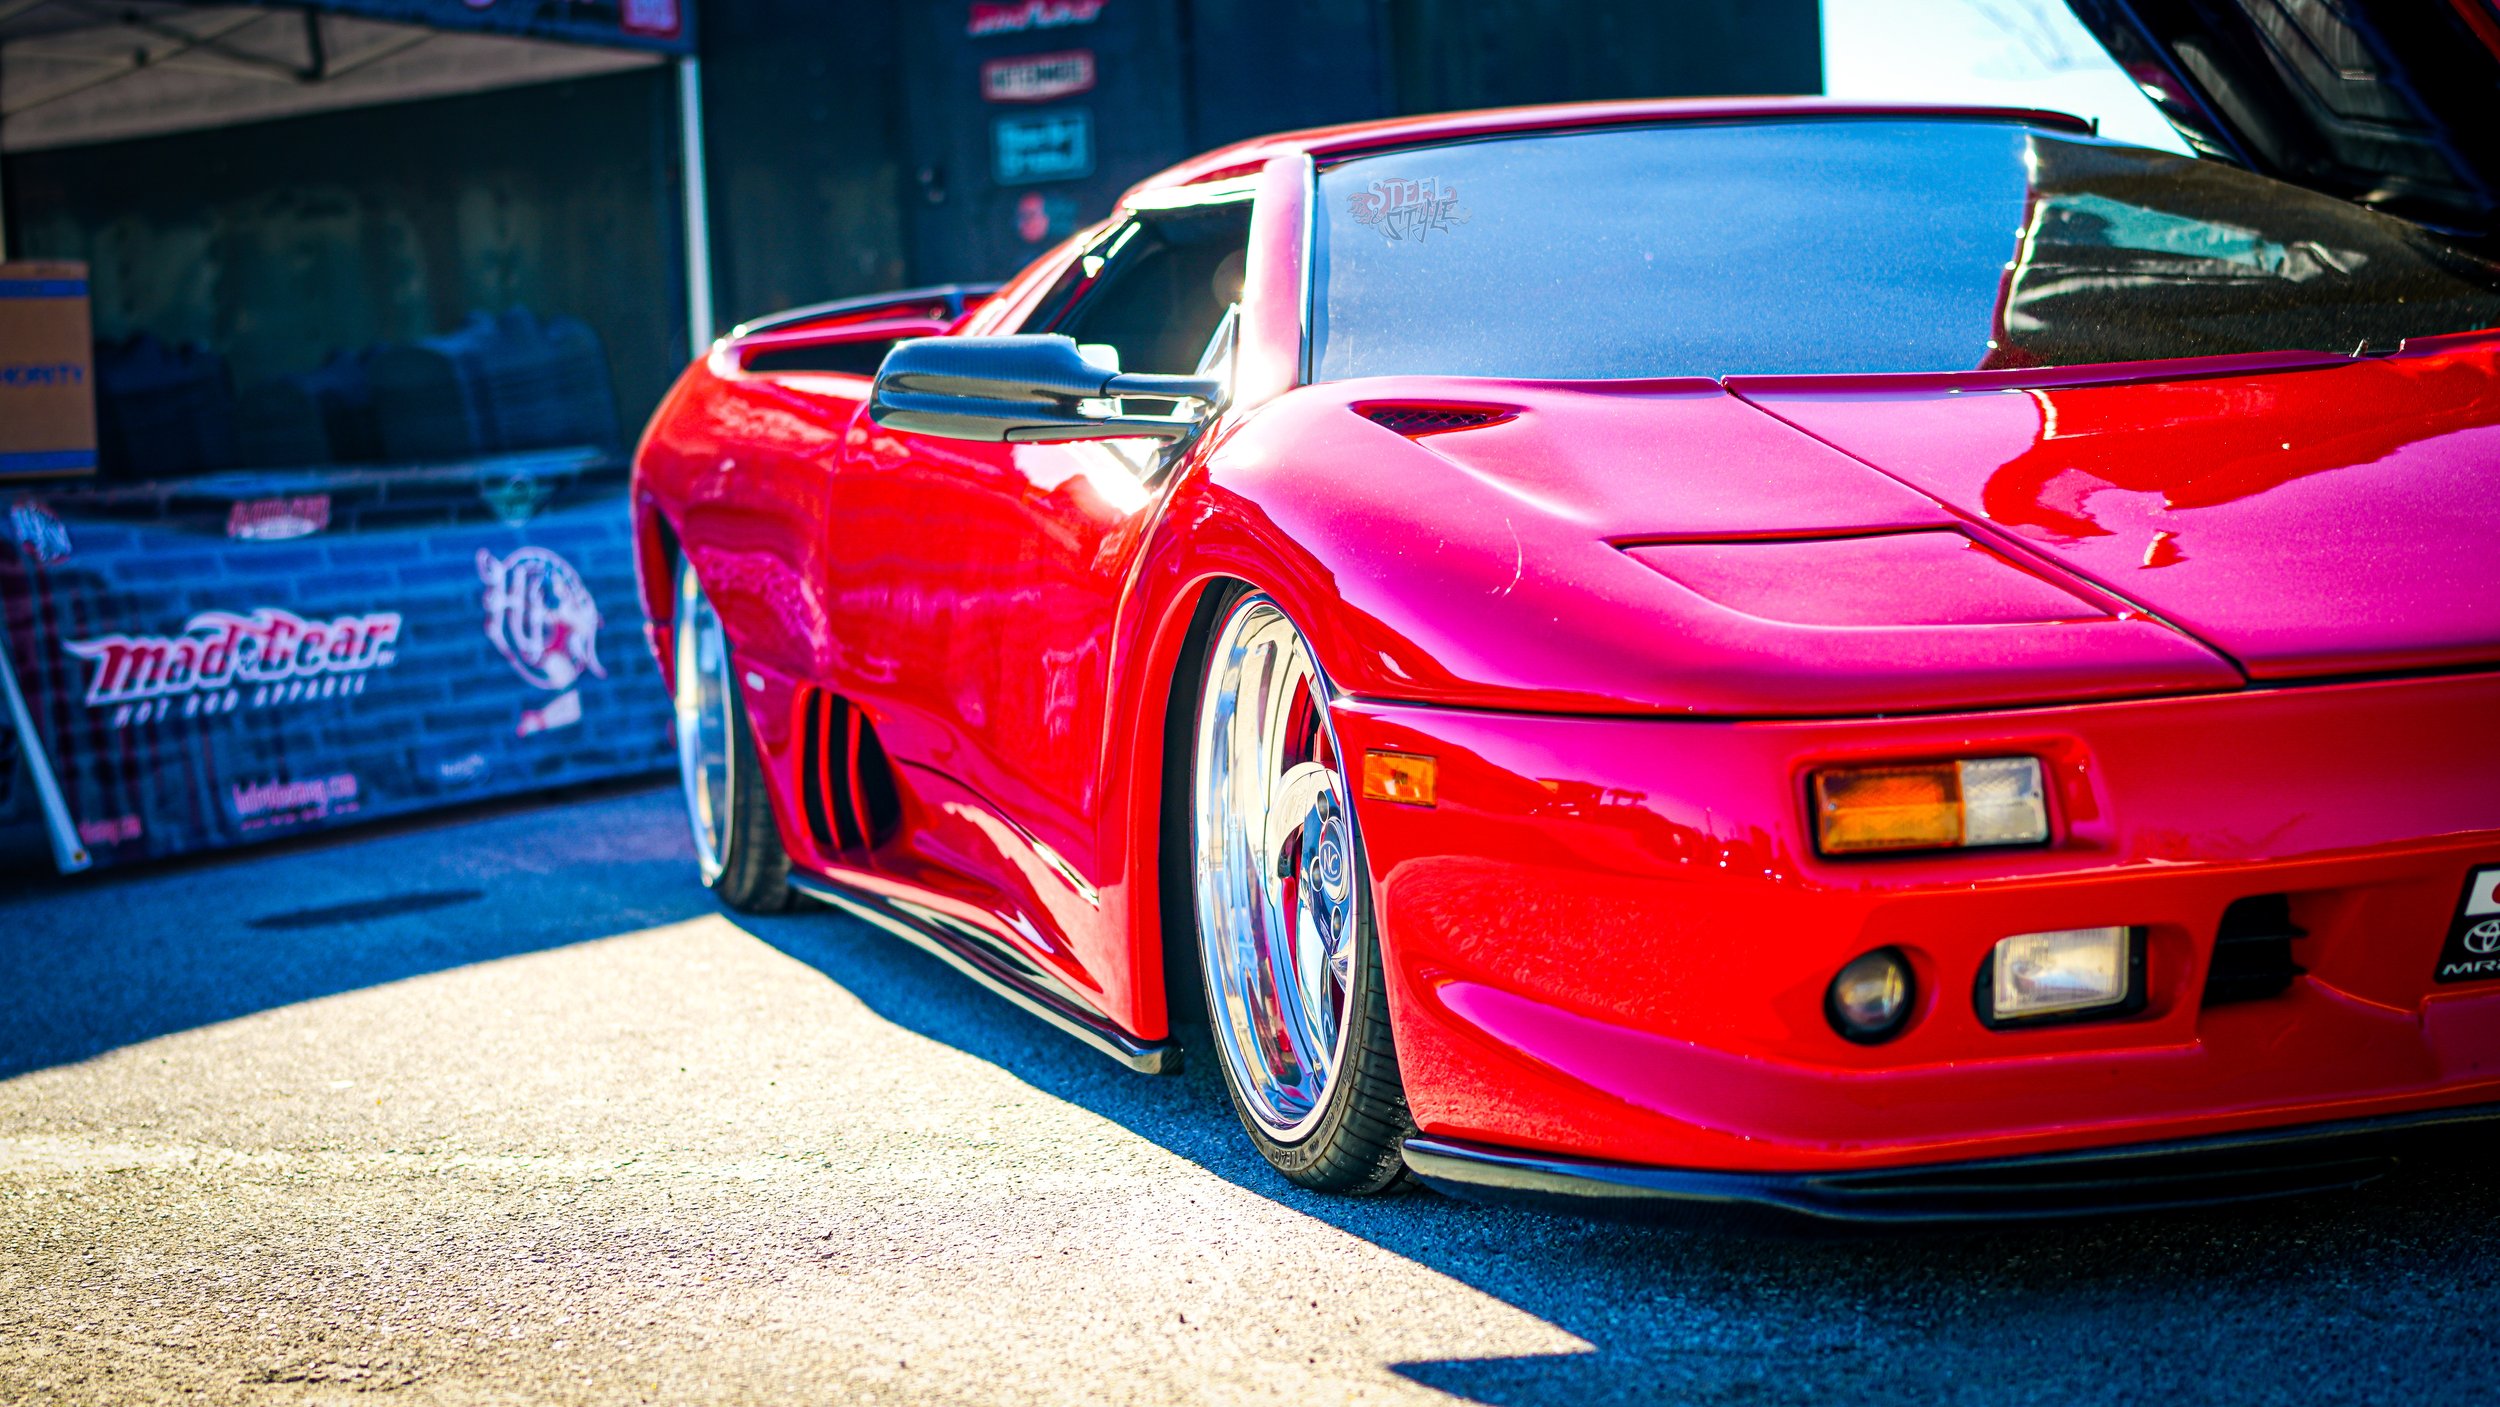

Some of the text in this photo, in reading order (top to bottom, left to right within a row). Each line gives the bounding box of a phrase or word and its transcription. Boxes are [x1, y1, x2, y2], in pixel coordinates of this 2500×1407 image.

[1366, 176, 1450, 212] STEEL
[1386, 198, 1459, 243] STYLE
[2441, 959, 2500, 976] MR
